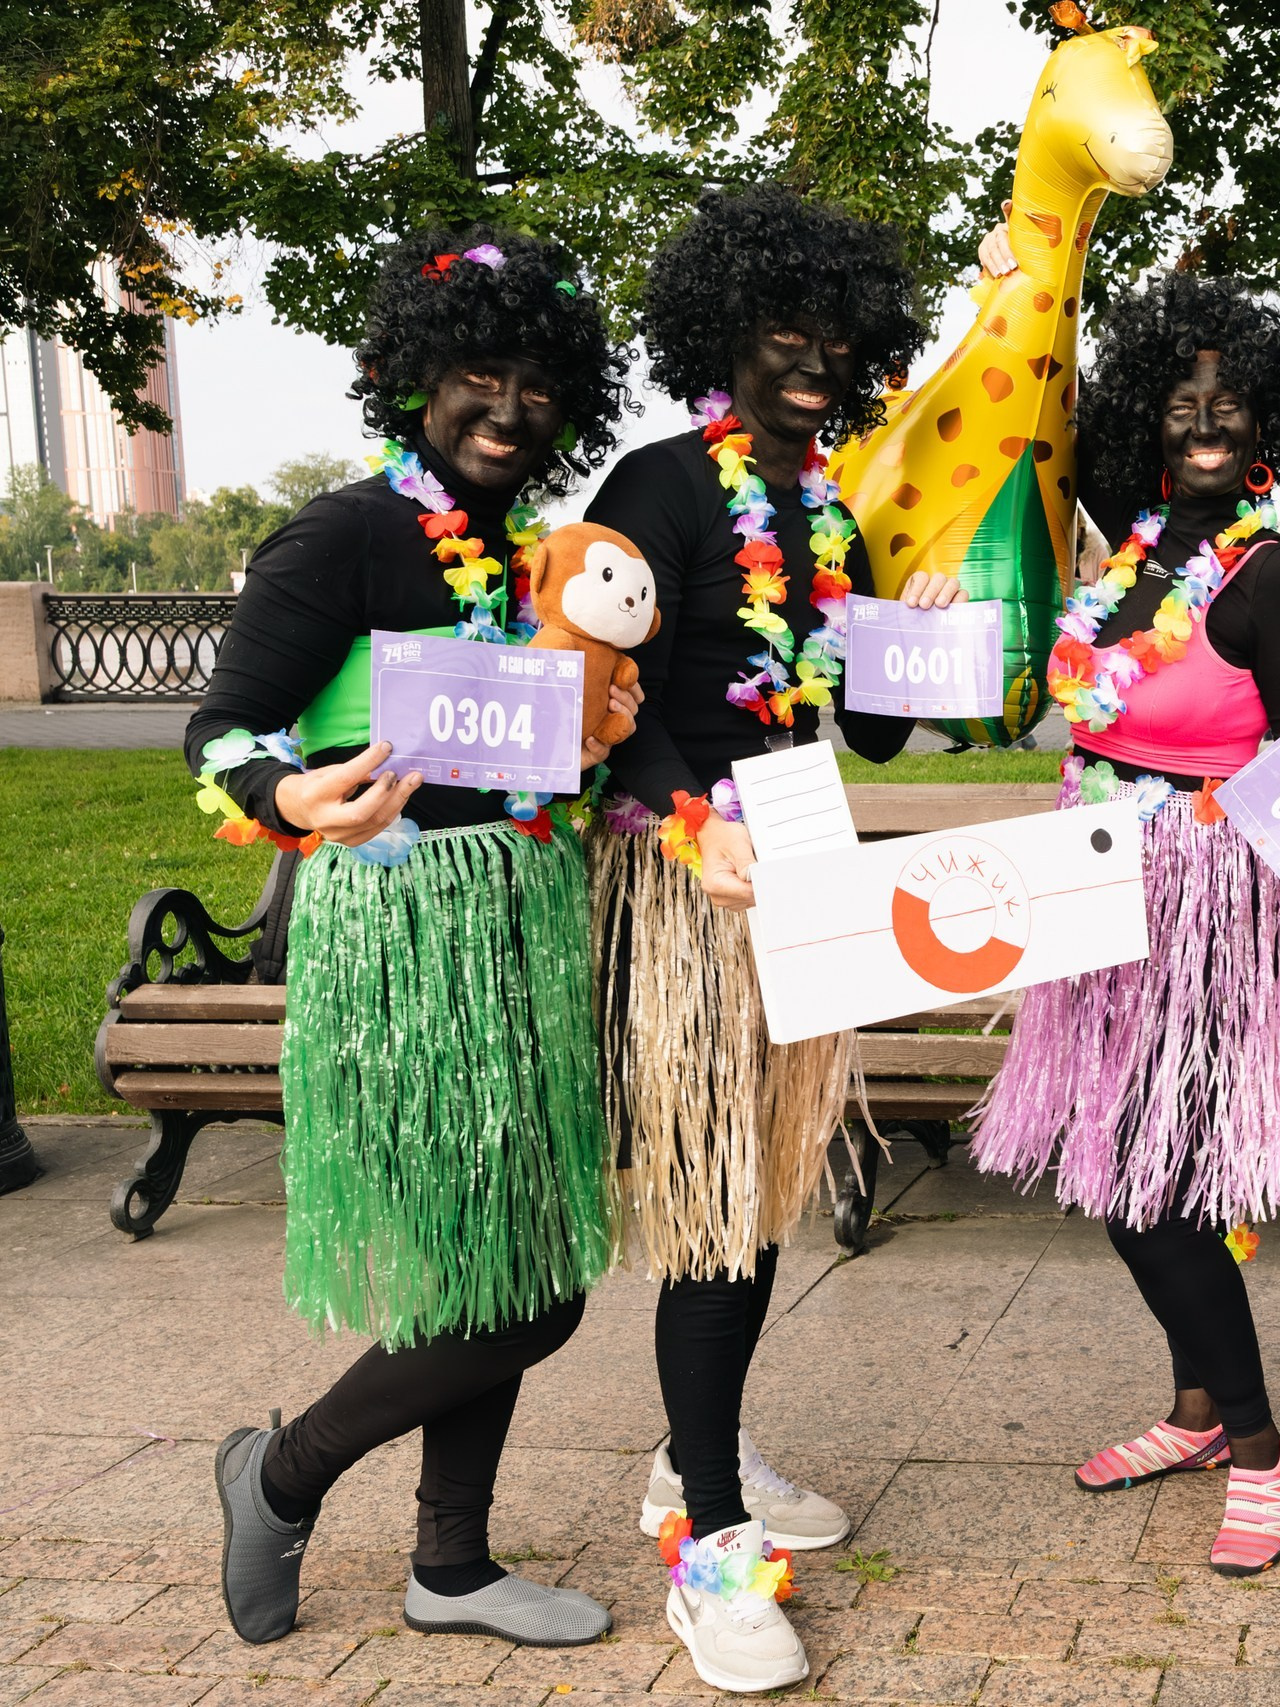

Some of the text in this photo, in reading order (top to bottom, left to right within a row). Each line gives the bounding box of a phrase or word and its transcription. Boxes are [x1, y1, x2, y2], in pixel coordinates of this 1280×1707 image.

[382, 646, 402, 662] 74
[884, 644, 964, 685] 0601
[429, 694, 535, 750] 0304
[910, 849, 1021, 918] ЧИЖИК
[724, 1542, 741, 1553] AIR
